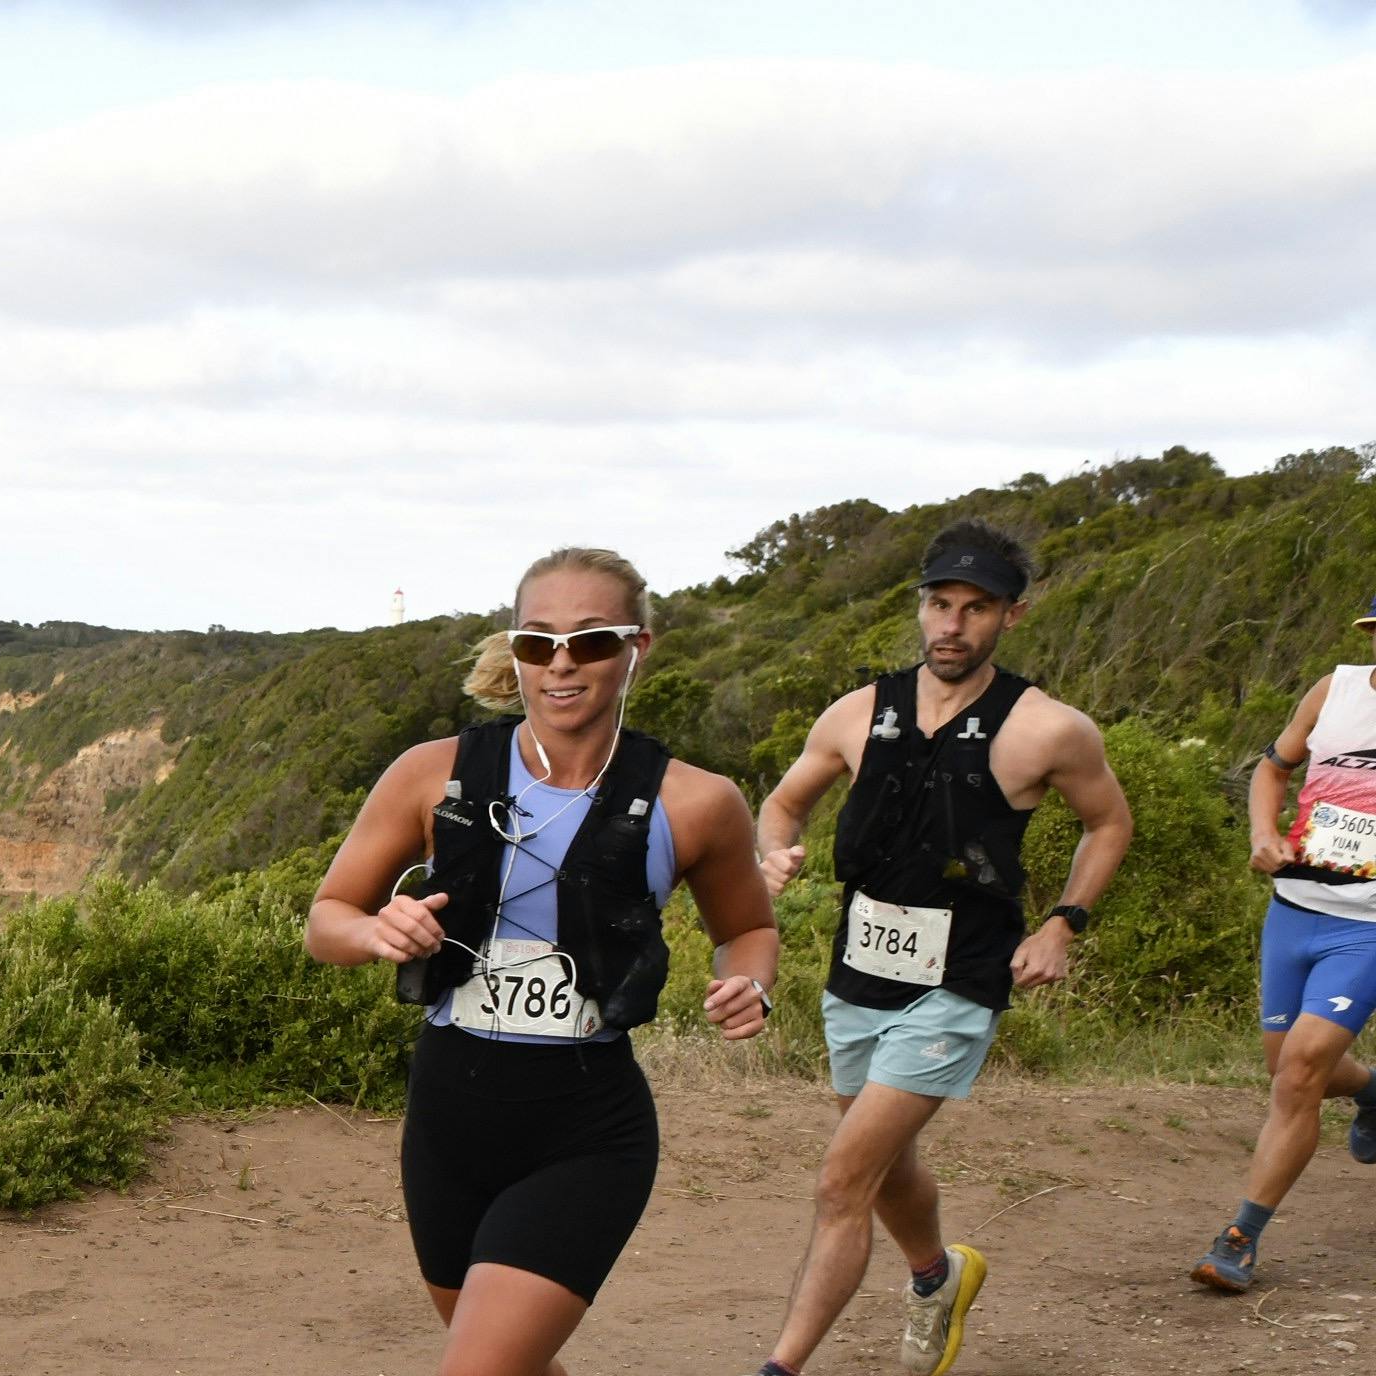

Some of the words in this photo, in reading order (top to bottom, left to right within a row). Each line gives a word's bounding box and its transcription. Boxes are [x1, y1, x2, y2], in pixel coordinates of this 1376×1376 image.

[1339, 813, 1376, 837] 5605
[1332, 834, 1361, 853] YUAN
[860, 921, 918, 958] 3784
[480, 973, 571, 1020] 3786
